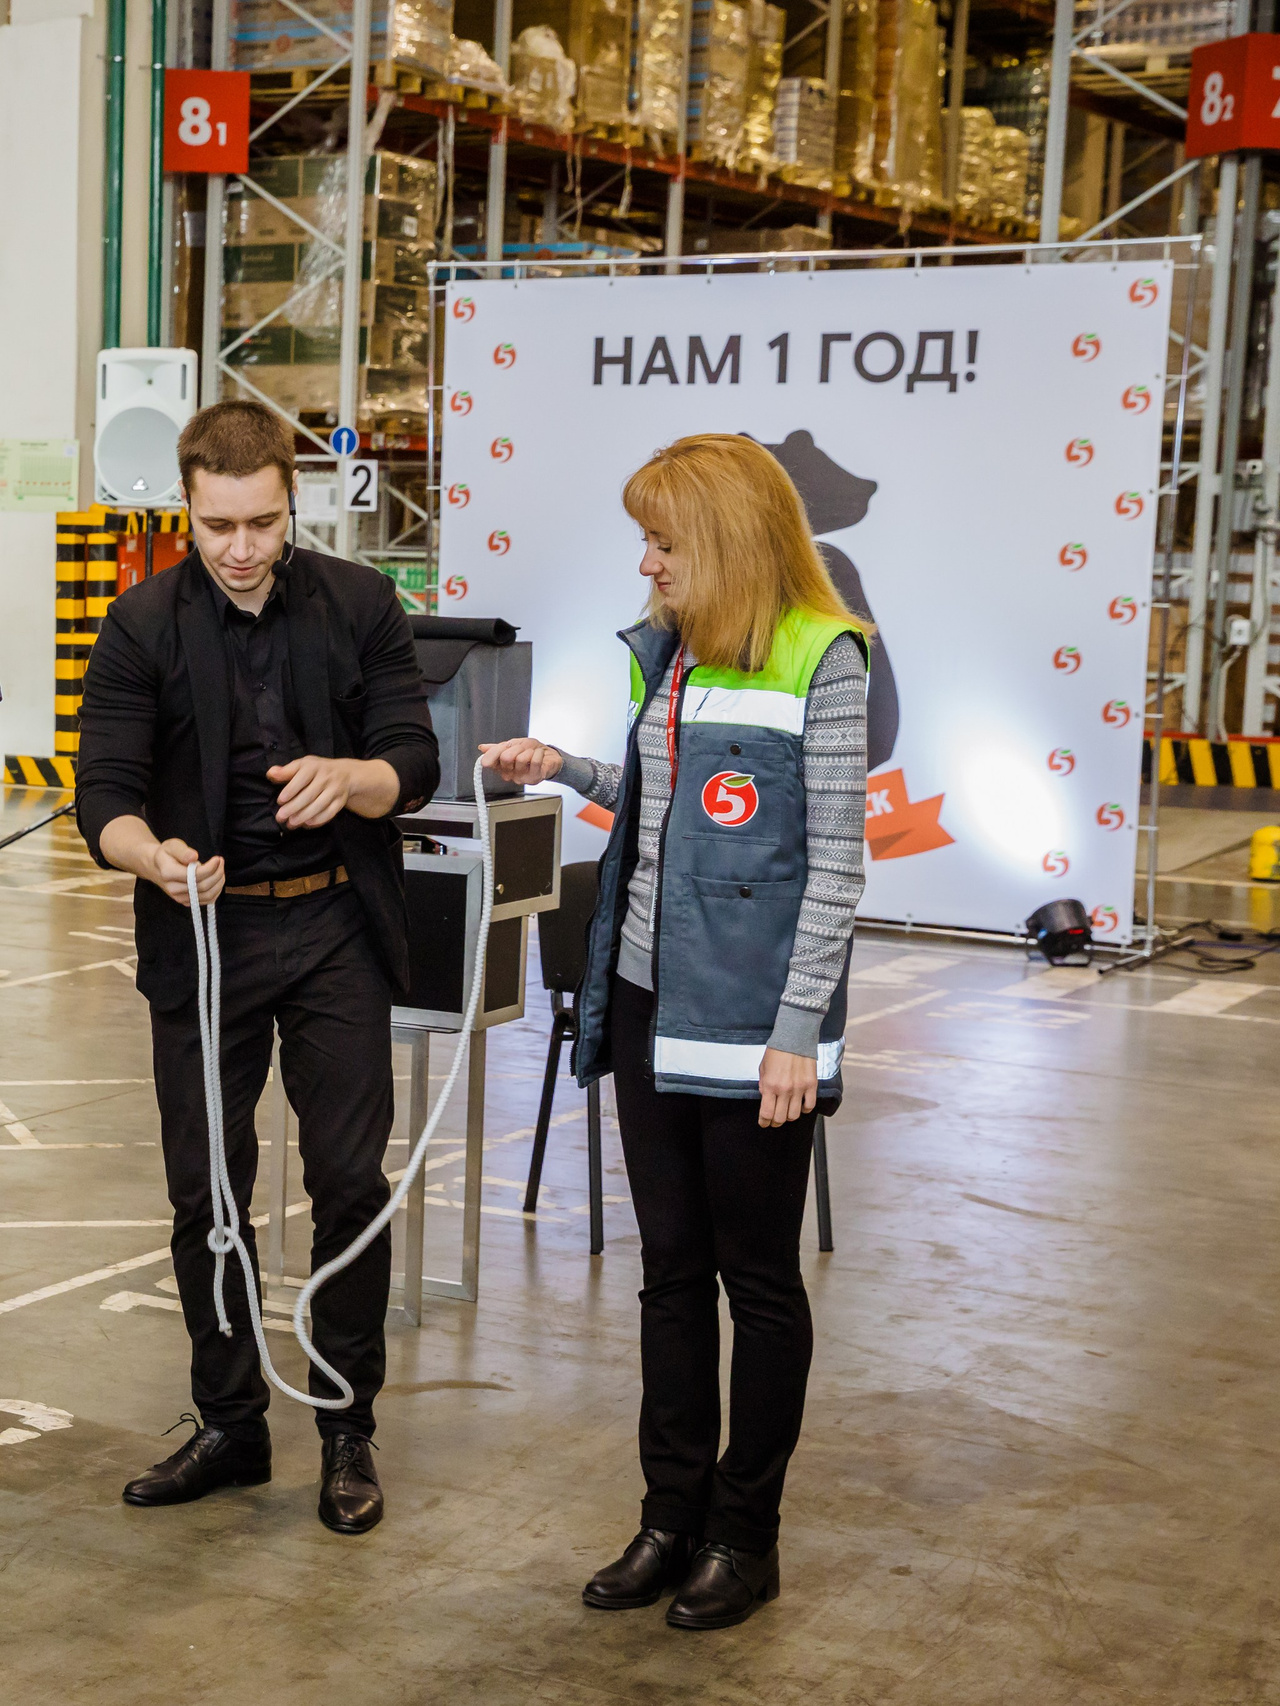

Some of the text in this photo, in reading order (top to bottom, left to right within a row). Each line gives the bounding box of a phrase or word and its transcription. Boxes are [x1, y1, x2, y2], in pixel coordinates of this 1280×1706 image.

[593, 330, 980, 393] НАМ 1 ГОД!
[350, 464, 372, 507] 2
